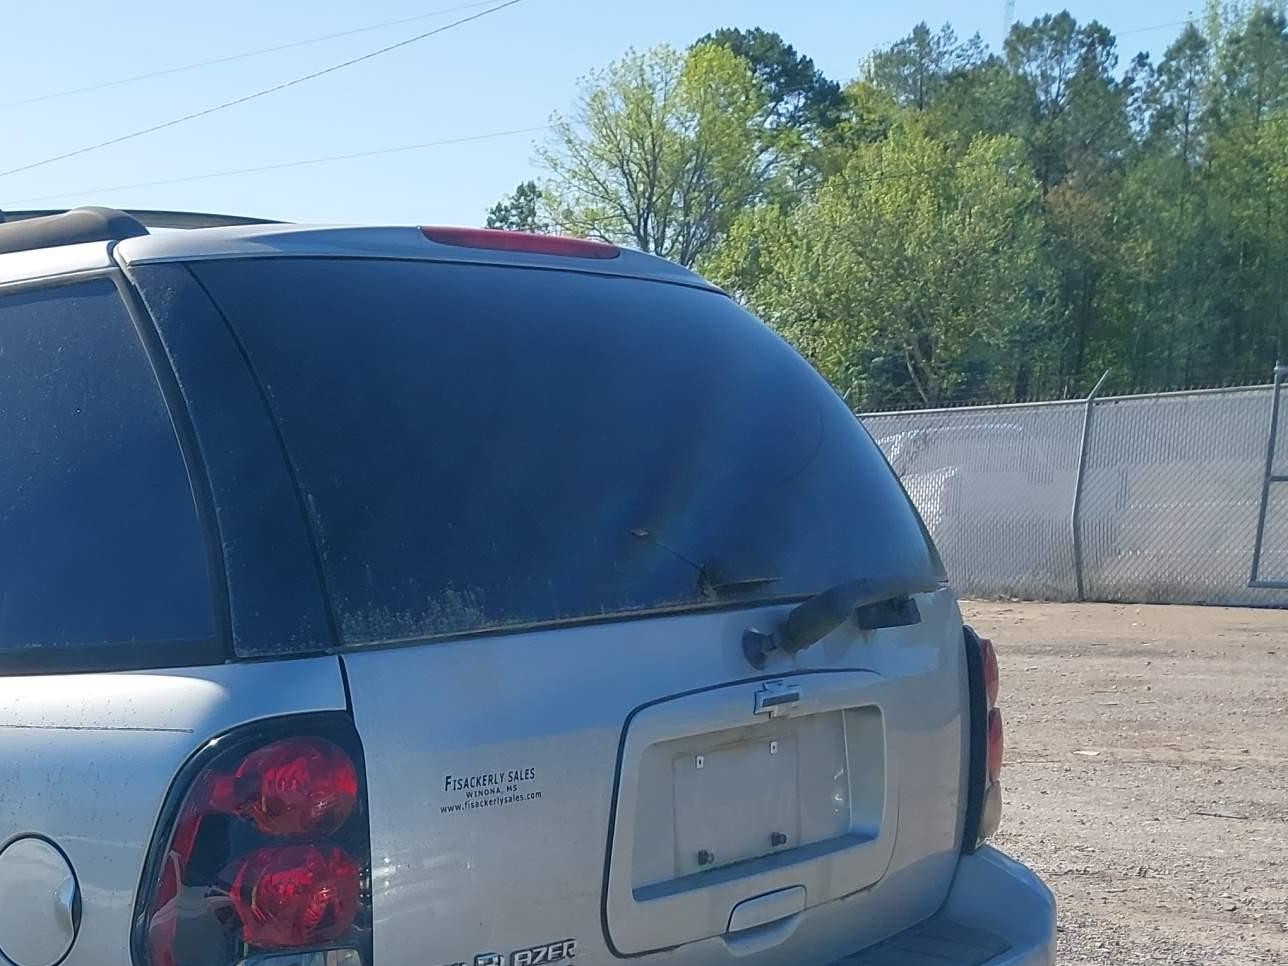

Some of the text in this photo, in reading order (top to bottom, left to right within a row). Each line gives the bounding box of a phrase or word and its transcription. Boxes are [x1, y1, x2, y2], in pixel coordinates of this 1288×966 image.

[444, 767, 535, 792] FISACKERLY SALES
[506, 784, 518, 793] MS
[440, 791, 542, 813] www.fisackerlysales.com
